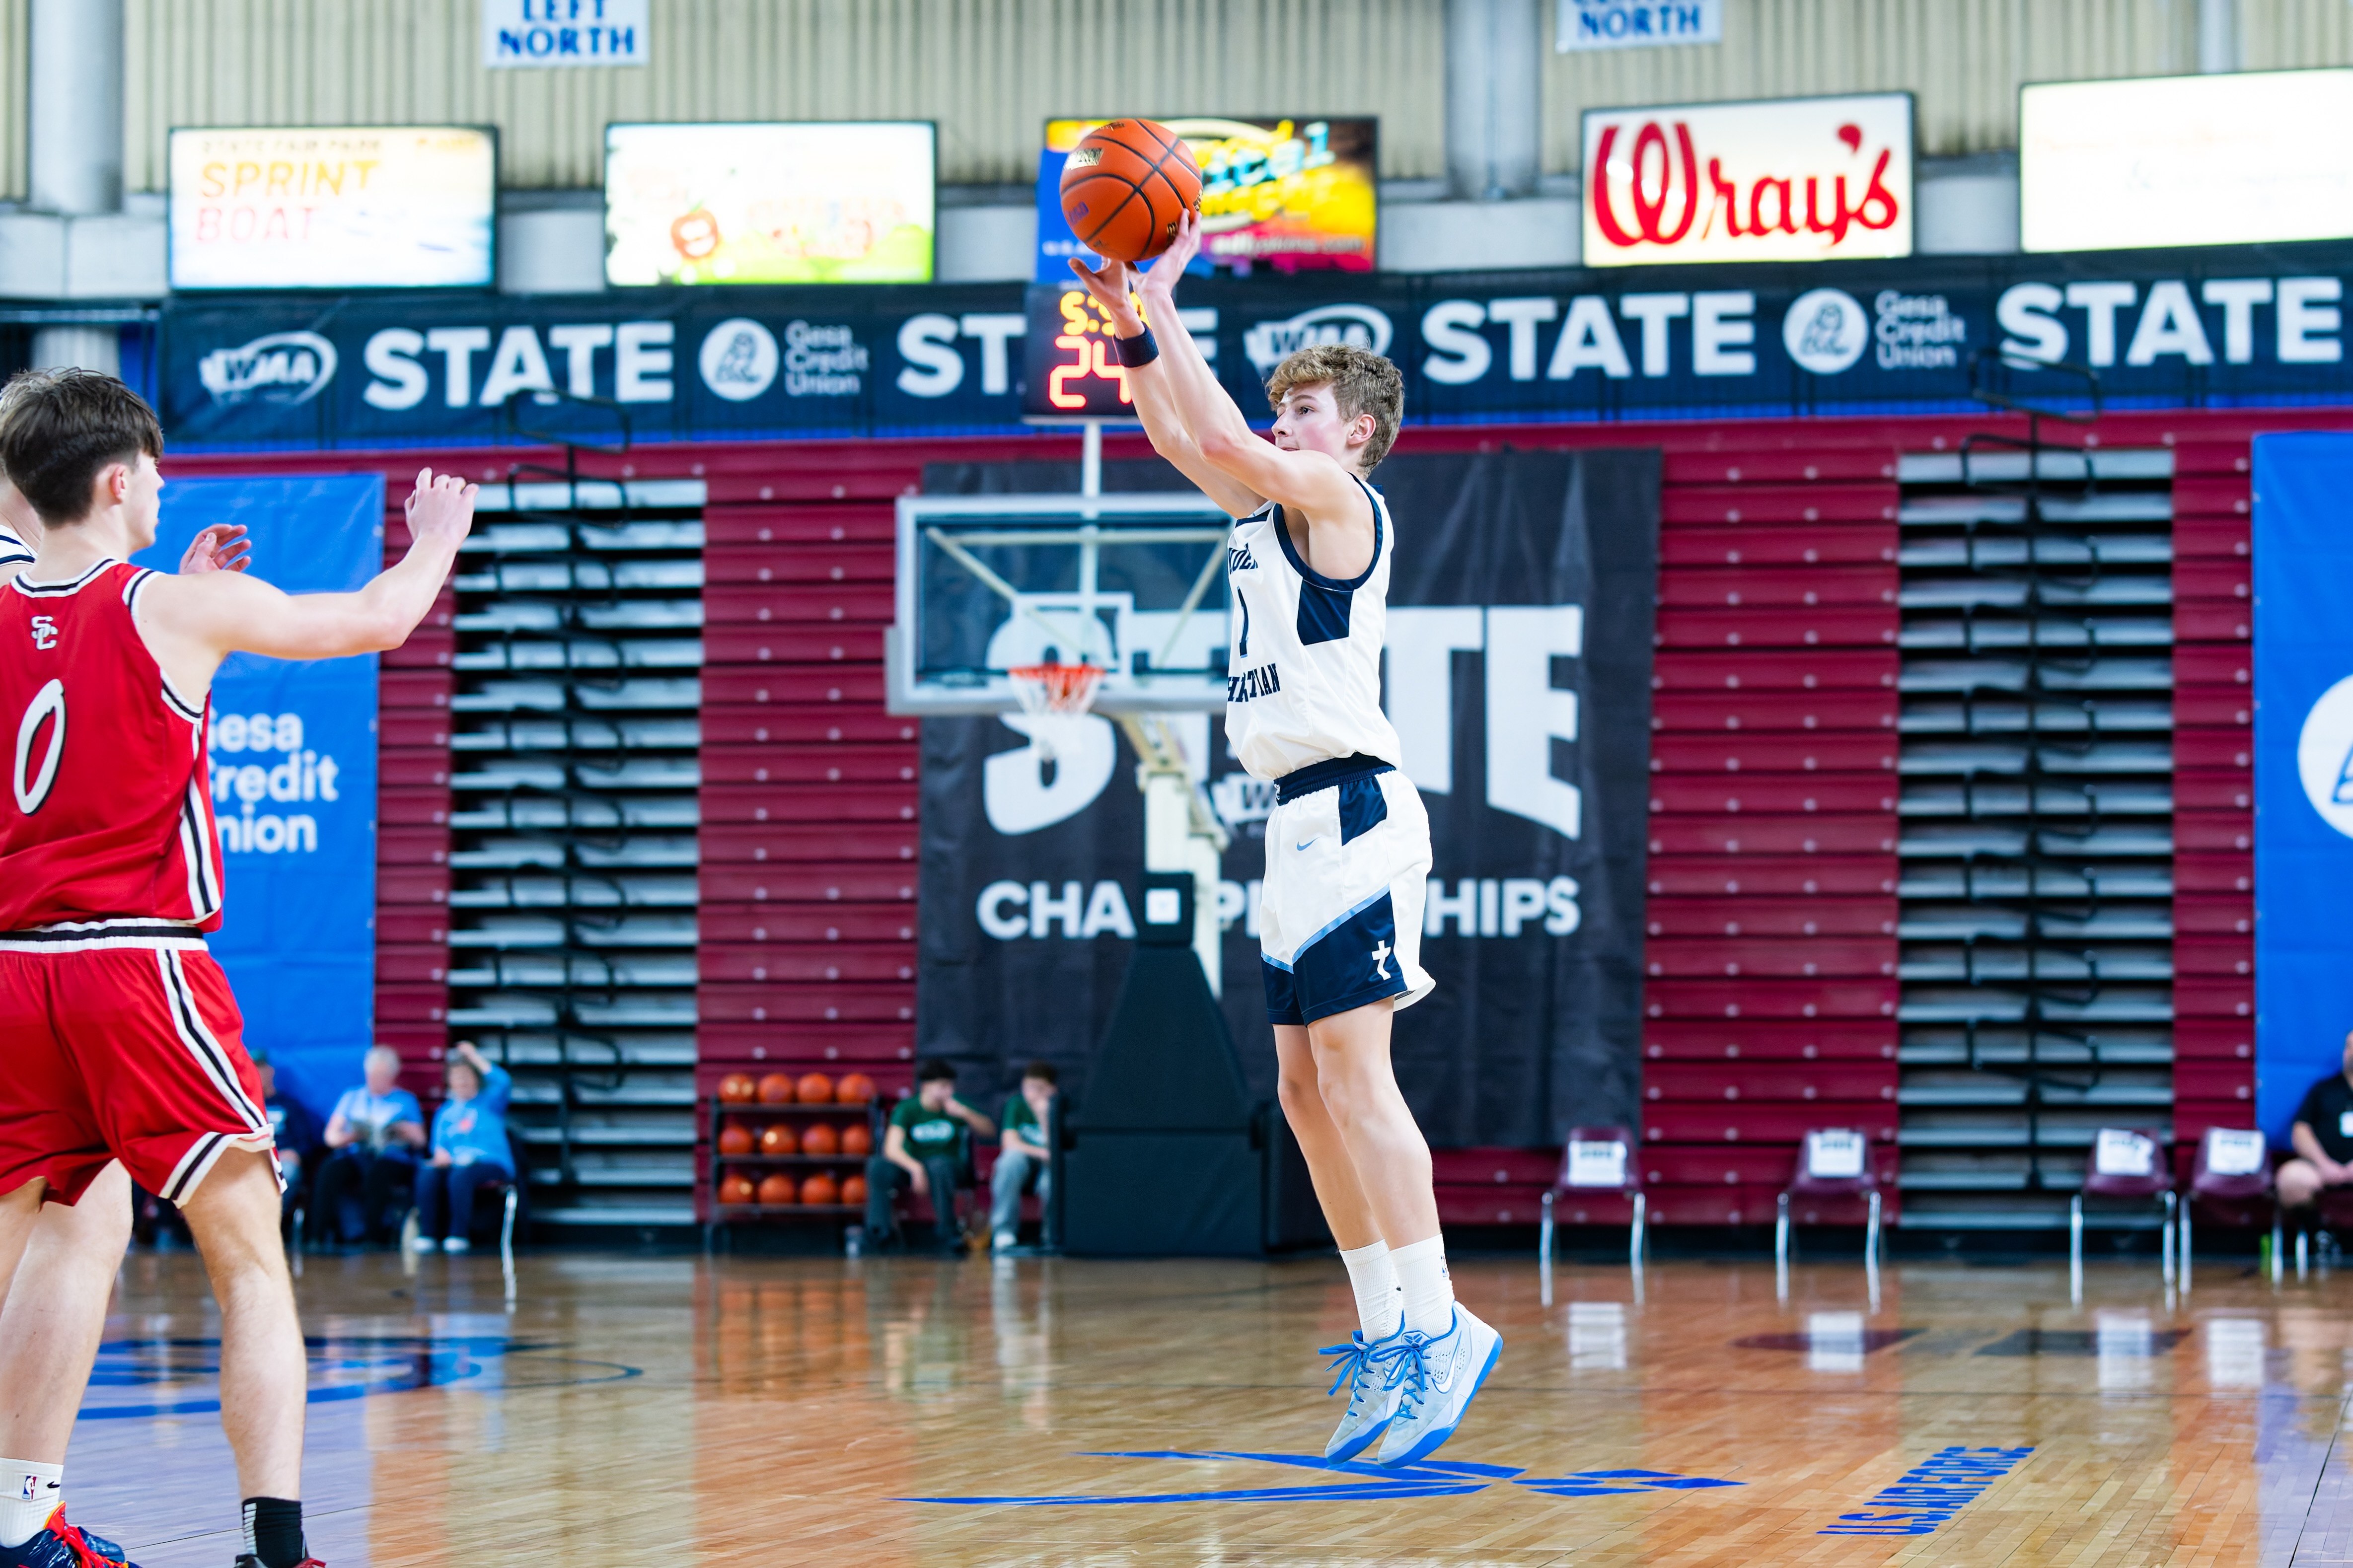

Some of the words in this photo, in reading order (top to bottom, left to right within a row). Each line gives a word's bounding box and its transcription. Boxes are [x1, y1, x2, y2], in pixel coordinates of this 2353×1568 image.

[497, 27, 634, 56] NORTH
[1578, 5, 1700, 39] NORTH
[201, 160, 380, 200] SPRINT
[1594, 121, 1898, 248] Wray's
[196, 206, 322, 244] BOAT
[1421, 290, 1756, 385] STATE
[1996, 276, 2343, 371] STATE
[363, 320, 674, 411] STATE
[13, 678, 67, 817] 0
[982, 604, 1584, 841] STTE
[216, 800, 318, 854] nion
[1896, 1446, 2035, 1485] FORCE
